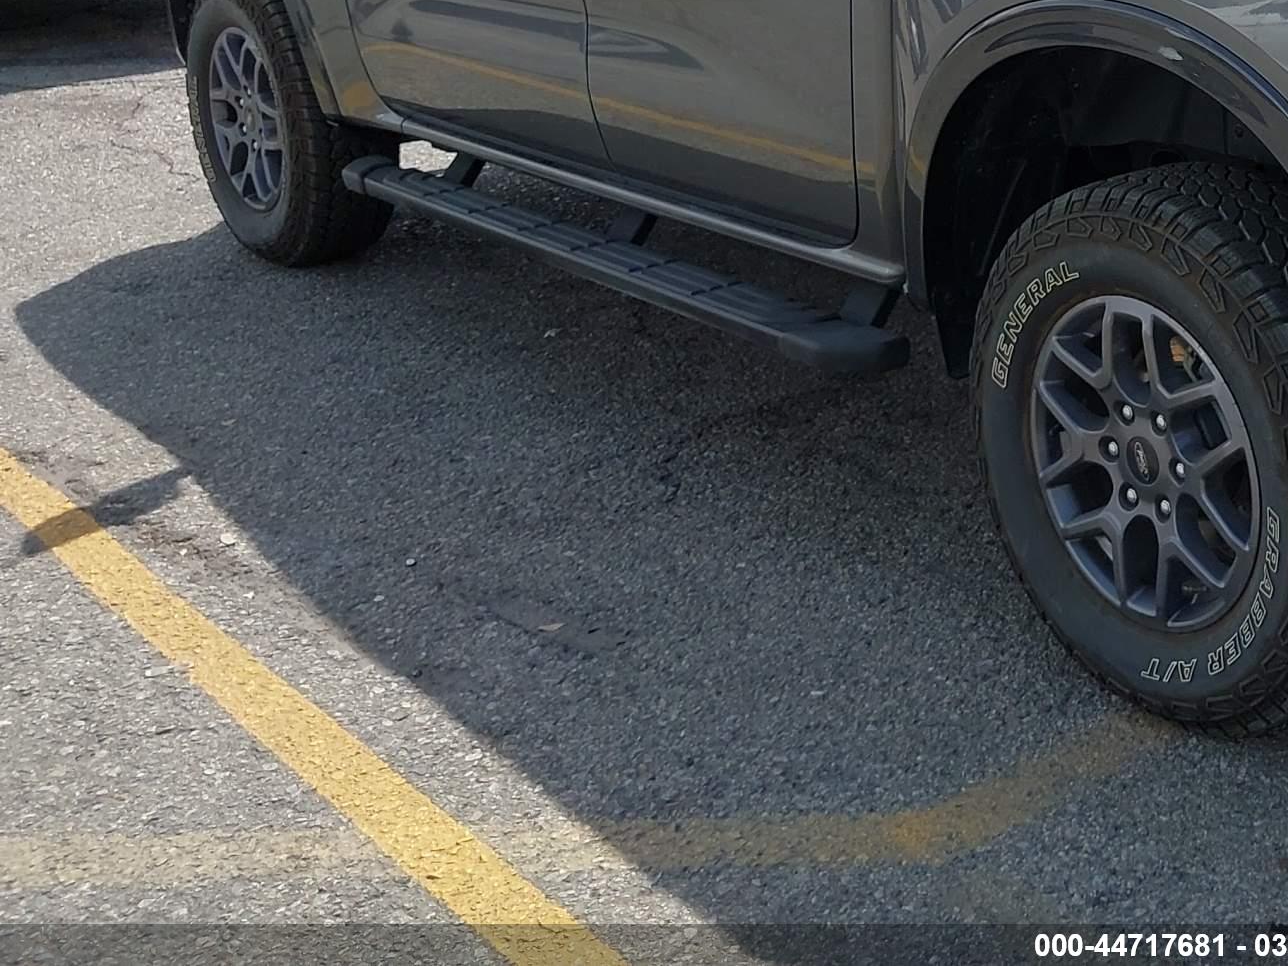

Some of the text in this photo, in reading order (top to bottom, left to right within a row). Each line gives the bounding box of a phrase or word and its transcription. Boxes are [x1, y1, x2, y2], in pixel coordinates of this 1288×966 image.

[991, 261, 1080, 389] GENERAL
[1140, 506, 1280, 683] GRABBER A/T
